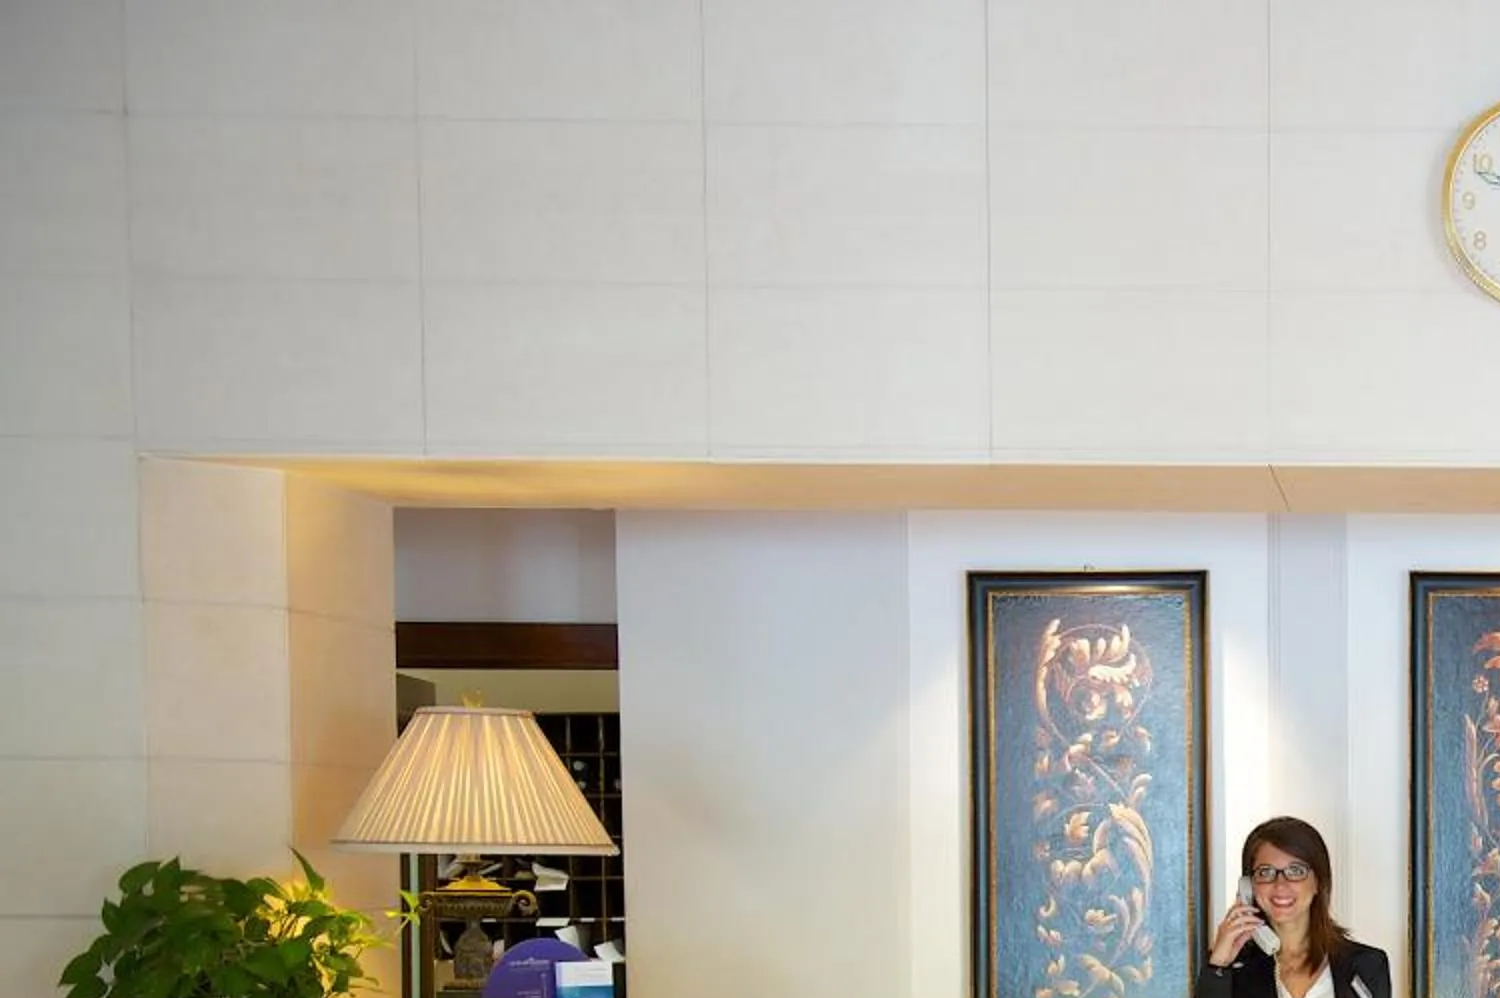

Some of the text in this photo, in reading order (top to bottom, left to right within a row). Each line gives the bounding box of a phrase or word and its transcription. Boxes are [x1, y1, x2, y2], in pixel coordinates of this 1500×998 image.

[1473, 153, 1493, 174] 10
[1462, 191, 1476, 210] 9
[1473, 230, 1487, 250] 8
